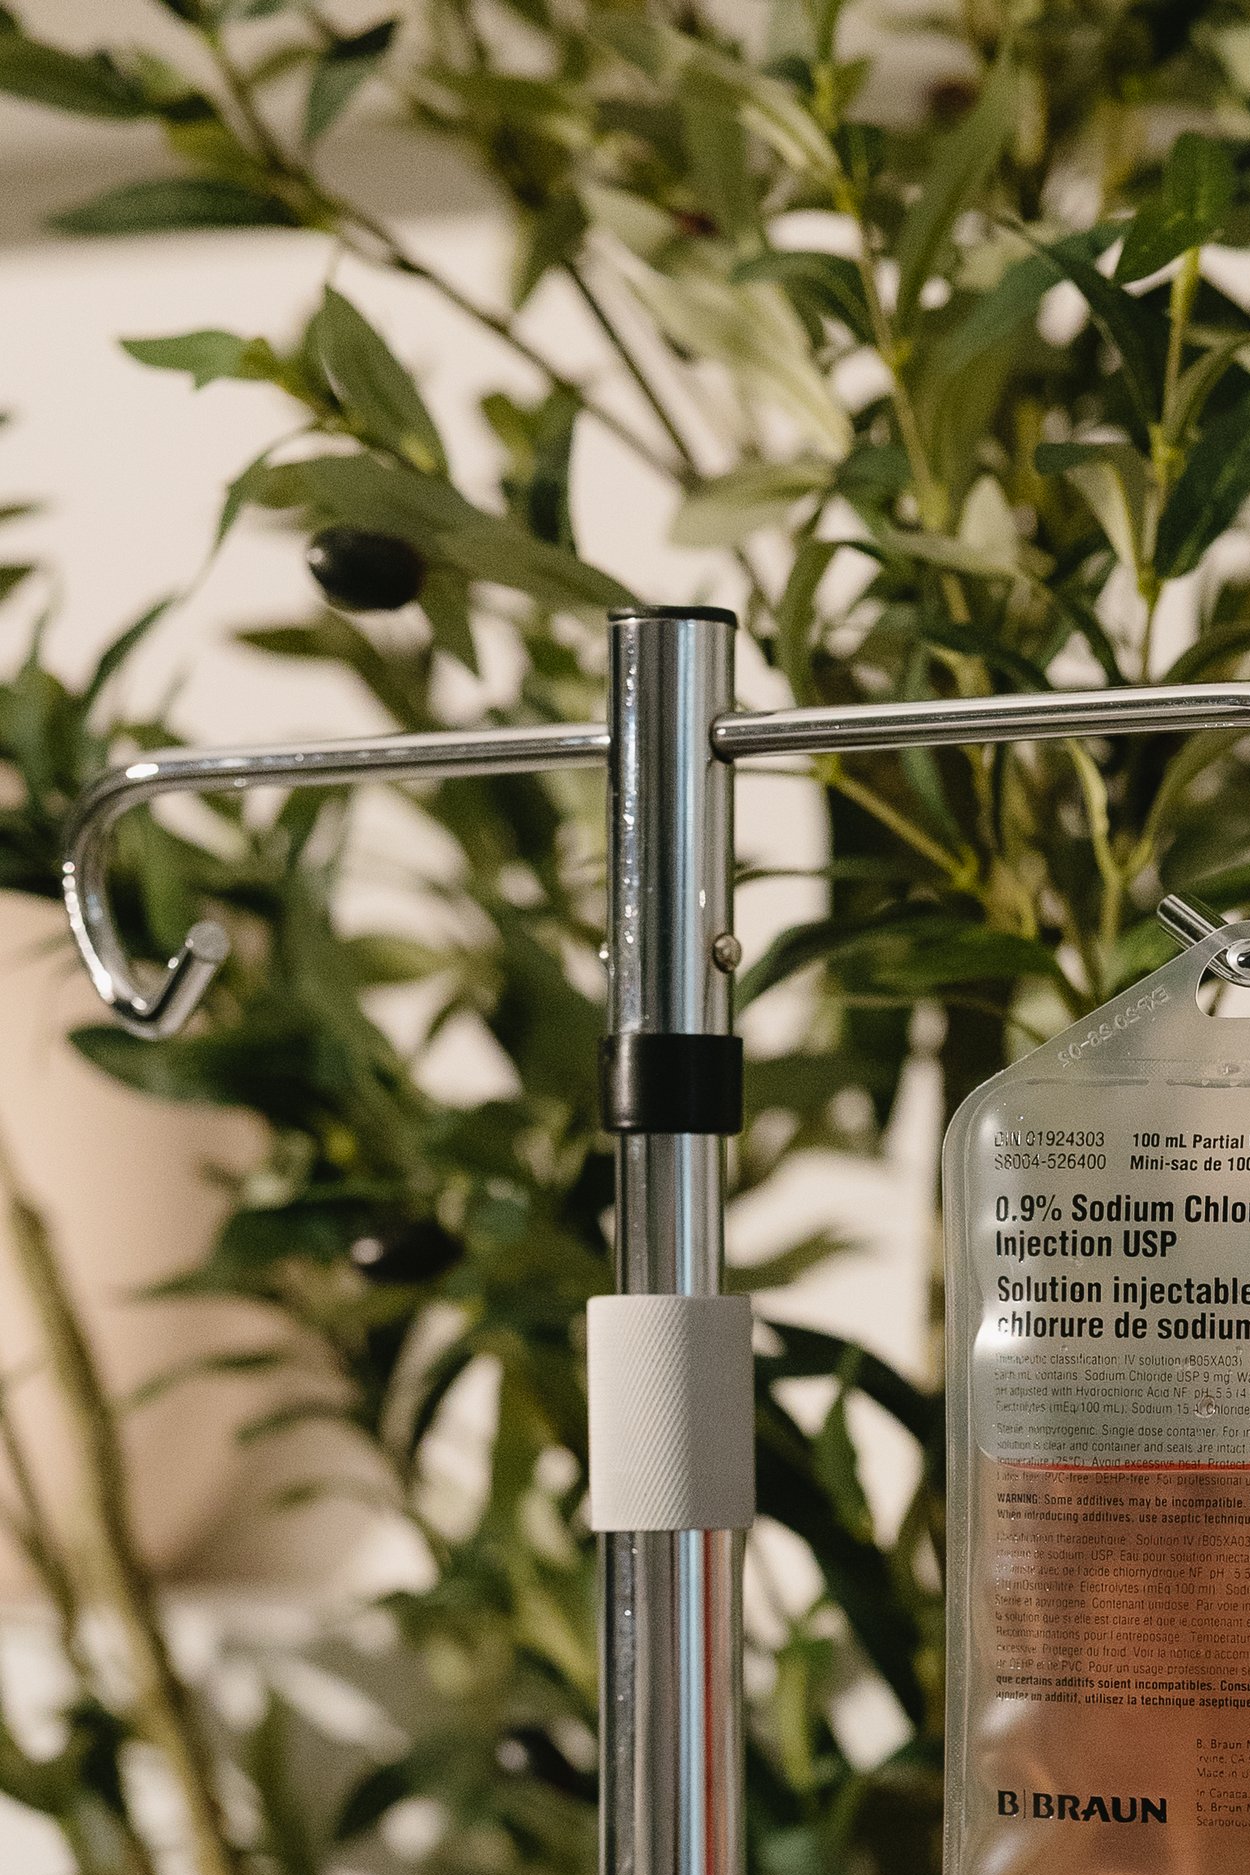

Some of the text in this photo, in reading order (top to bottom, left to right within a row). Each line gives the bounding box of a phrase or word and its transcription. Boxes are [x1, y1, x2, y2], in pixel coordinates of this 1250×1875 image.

[994, 1131, 1105, 1147] DIN 01924303
[1132, 1133, 1160, 1148] 100
[1165, 1133, 1187, 1148] mL
[1192, 1134, 1244, 1149] Partial
[994, 1154, 1107, 1170] S8004-526400
[1130, 1155, 1198, 1171] Mini-sac
[1203, 1156, 1222, 1171] de
[995, 1194, 1062, 1222] 0.9%
[1071, 1193, 1174, 1223] Sodium
[995, 1229, 1177, 1263] Injection USP
[997, 1275, 1102, 1303] Solution
[997, 1310, 1104, 1338] chlorure
[1114, 1311, 1147, 1339] de
[1124, 1355, 1135, 1365] IV
[1139, 1355, 1181, 1367] solution
[1084, 1370, 1125, 1382] Sodium
[1129, 1370, 1173, 1383] Chloride
[1176, 1371, 1200, 1383] USP
[1203, 1371, 1210, 1383] 9
[1131, 1402, 1173, 1414] Sodium
[1138, 1425, 1162, 1437] dose
[1070, 1440, 1088, 1451] and
[1092, 1441, 1141, 1452] container
[1144, 1441, 1163, 1452] and
[996, 1492, 1041, 1505] WARNING:
[1044, 1493, 1073, 1505] Some
[1076, 1494, 1125, 1507] additives
[1129, 1496, 1151, 1509] may
[1155, 1496, 1168, 1508] be
[1171, 1496, 1247, 1510] incompatible.
[996, 1509, 1021, 1520] When
[1024, 1510, 1079, 1524] introducing
[1139, 1513, 1158, 1524] use
[1161, 1513, 1204, 1526] aseptic
[1133, 1664, 1164, 1676] usage
[996, 1675, 1013, 1686] que
[1015, 1675, 1051, 1687] certains
[1055, 1676, 1095, 1688] additifs
[1097, 1678, 1131, 1689] soient
[1135, 1679, 1216, 1692] incompatibles.
[1085, 1693, 1124, 1705] utilisez
[1127, 1694, 1137, 1706] la
[1141, 1694, 1195, 1708] technique
[1210, 1739, 1242, 1750] Braun
[1032, 1792, 1168, 1823] BRAUN
